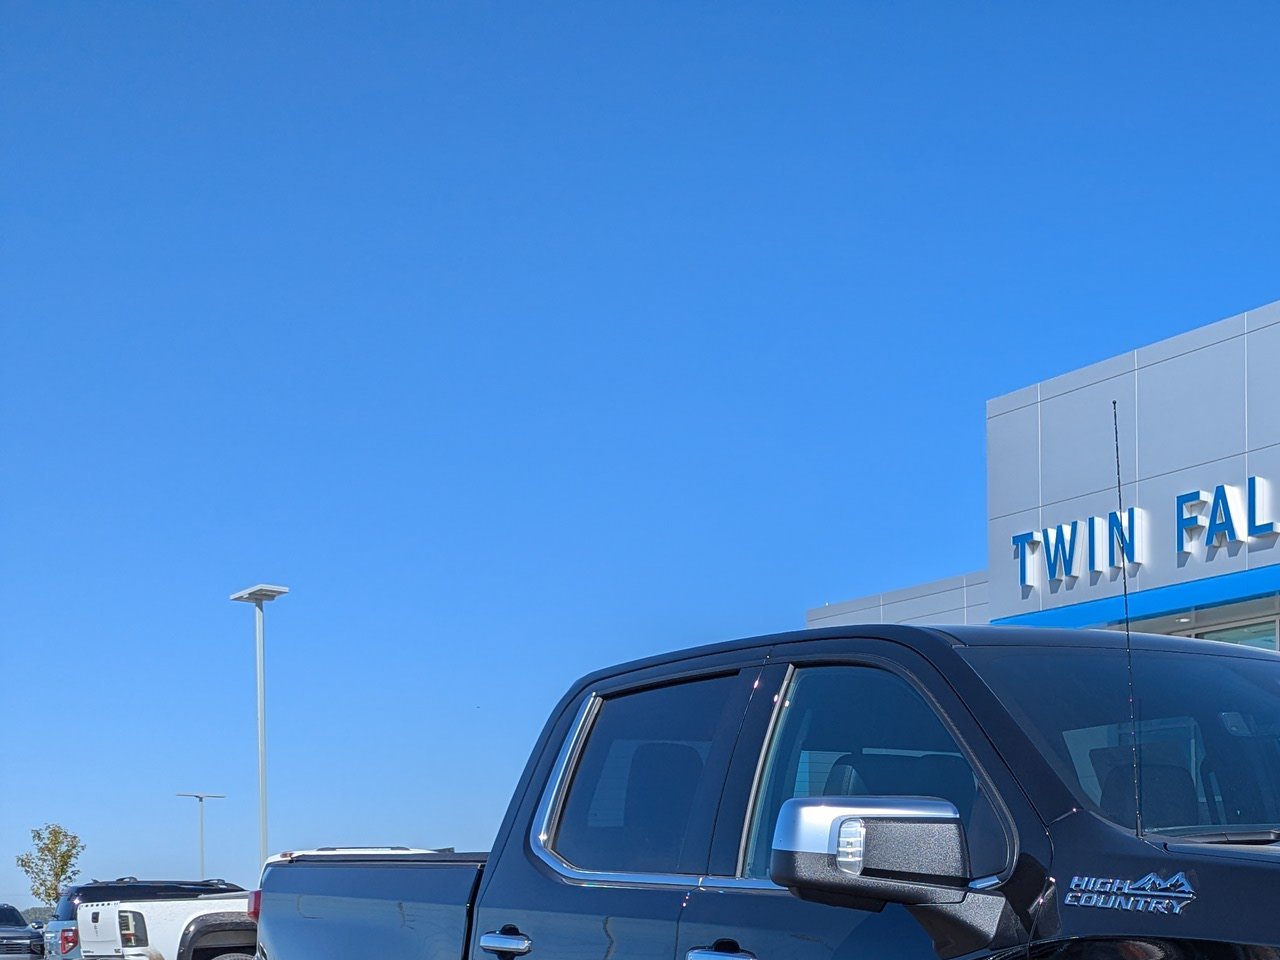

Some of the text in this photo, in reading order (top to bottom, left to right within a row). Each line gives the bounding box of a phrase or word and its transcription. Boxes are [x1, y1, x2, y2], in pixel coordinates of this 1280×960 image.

[1011, 507, 1141, 587] TWIN
[1069, 876, 1131, 893] HIGH
[1064, 893, 1191, 915] COUNTRY
